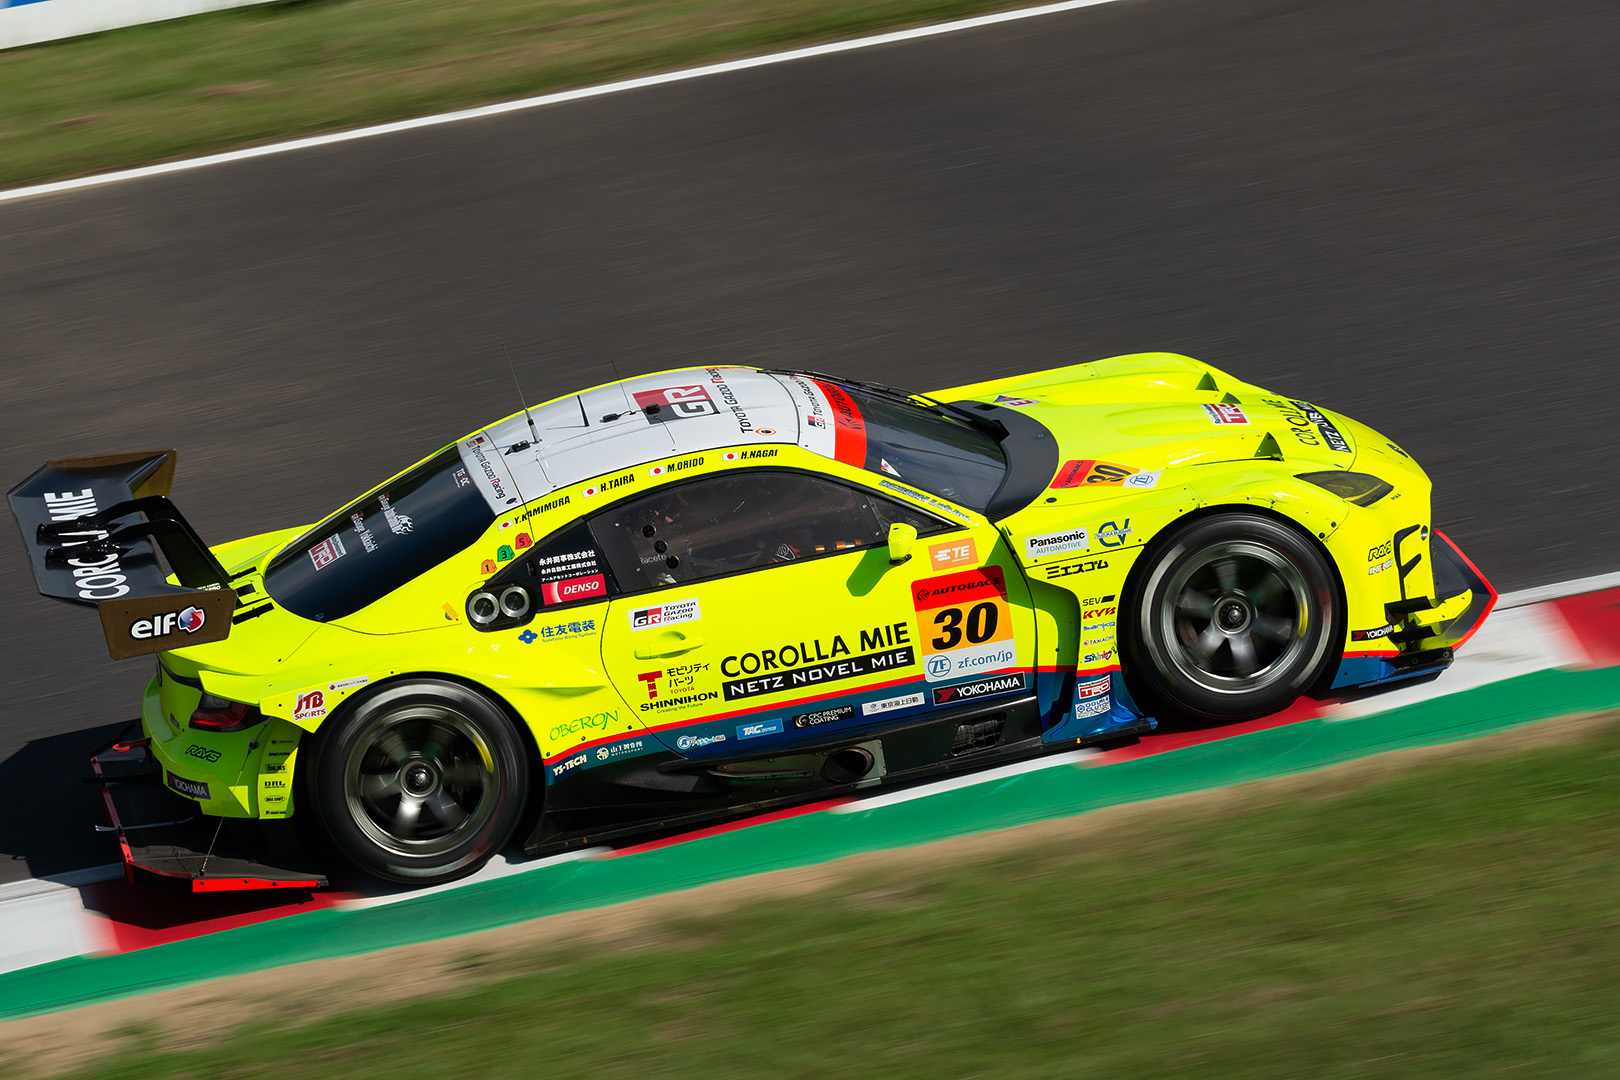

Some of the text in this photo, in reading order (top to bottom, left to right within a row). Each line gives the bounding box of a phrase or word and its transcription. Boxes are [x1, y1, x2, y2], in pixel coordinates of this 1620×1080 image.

[716, 383, 739, 406] GAZOO
[730, 405, 754, 434] TOYOTA
[740, 449, 779, 460] H.NAGAI
[471, 445, 484, 463] TOYOTA
[480, 460, 495, 479] GAZOO
[489, 477, 506, 500] Racing
[667, 457, 705, 473] M.ORIDO
[600, 474, 635, 492] H.TAIRA
[514, 496, 571, 525] Y.KAMIMURA
[1030, 530, 1086, 548] Panasonic
[485, 538, 525, 573] 1 3 5
[951, 544, 970, 558] TE
[1036, 541, 1082, 554] AUTOMOTIVE
[563, 581, 600, 596] DENSO
[931, 577, 1001, 596] AUTOBACS
[663, 601, 697, 611] TOYOTA
[1082, 597, 1102, 607] SEV
[663, 607, 694, 617] GAZOO
[663, 613, 693, 622] Racing
[1083, 607, 1117, 620] KYB
[131, 613, 176, 639] elf
[634, 613, 662, 628] GR
[931, 602, 999, 651] 30
[540, 620, 596, 638] 住友電装
[720, 622, 910, 677] COROLLA MIE
[931, 658, 949, 674] ZF
[957, 650, 1013, 670] zf.com/jp
[666, 662, 710, 678] モビリティ
[730, 652, 908, 696] NETZ NOVEL MIE
[669, 675, 694, 688] パーツ
[956, 677, 1021, 697] YOKOHAMA
[670, 686, 695, 694] TOYOTA
[1080, 682, 1109, 698] TRD
[294, 690, 325, 715] JTB
[640, 691, 718, 712] SHINNIHON
[880, 696, 919, 709] 東京海上日動
[294, 708, 326, 721] SPORTS
[809, 713, 839, 725] COATING
[822, 707, 852, 718] PREMIUM
[549, 709, 619, 741] OBERON
[185, 745, 221, 762] RAYS
[553, 754, 588, 776] YS-TECH
